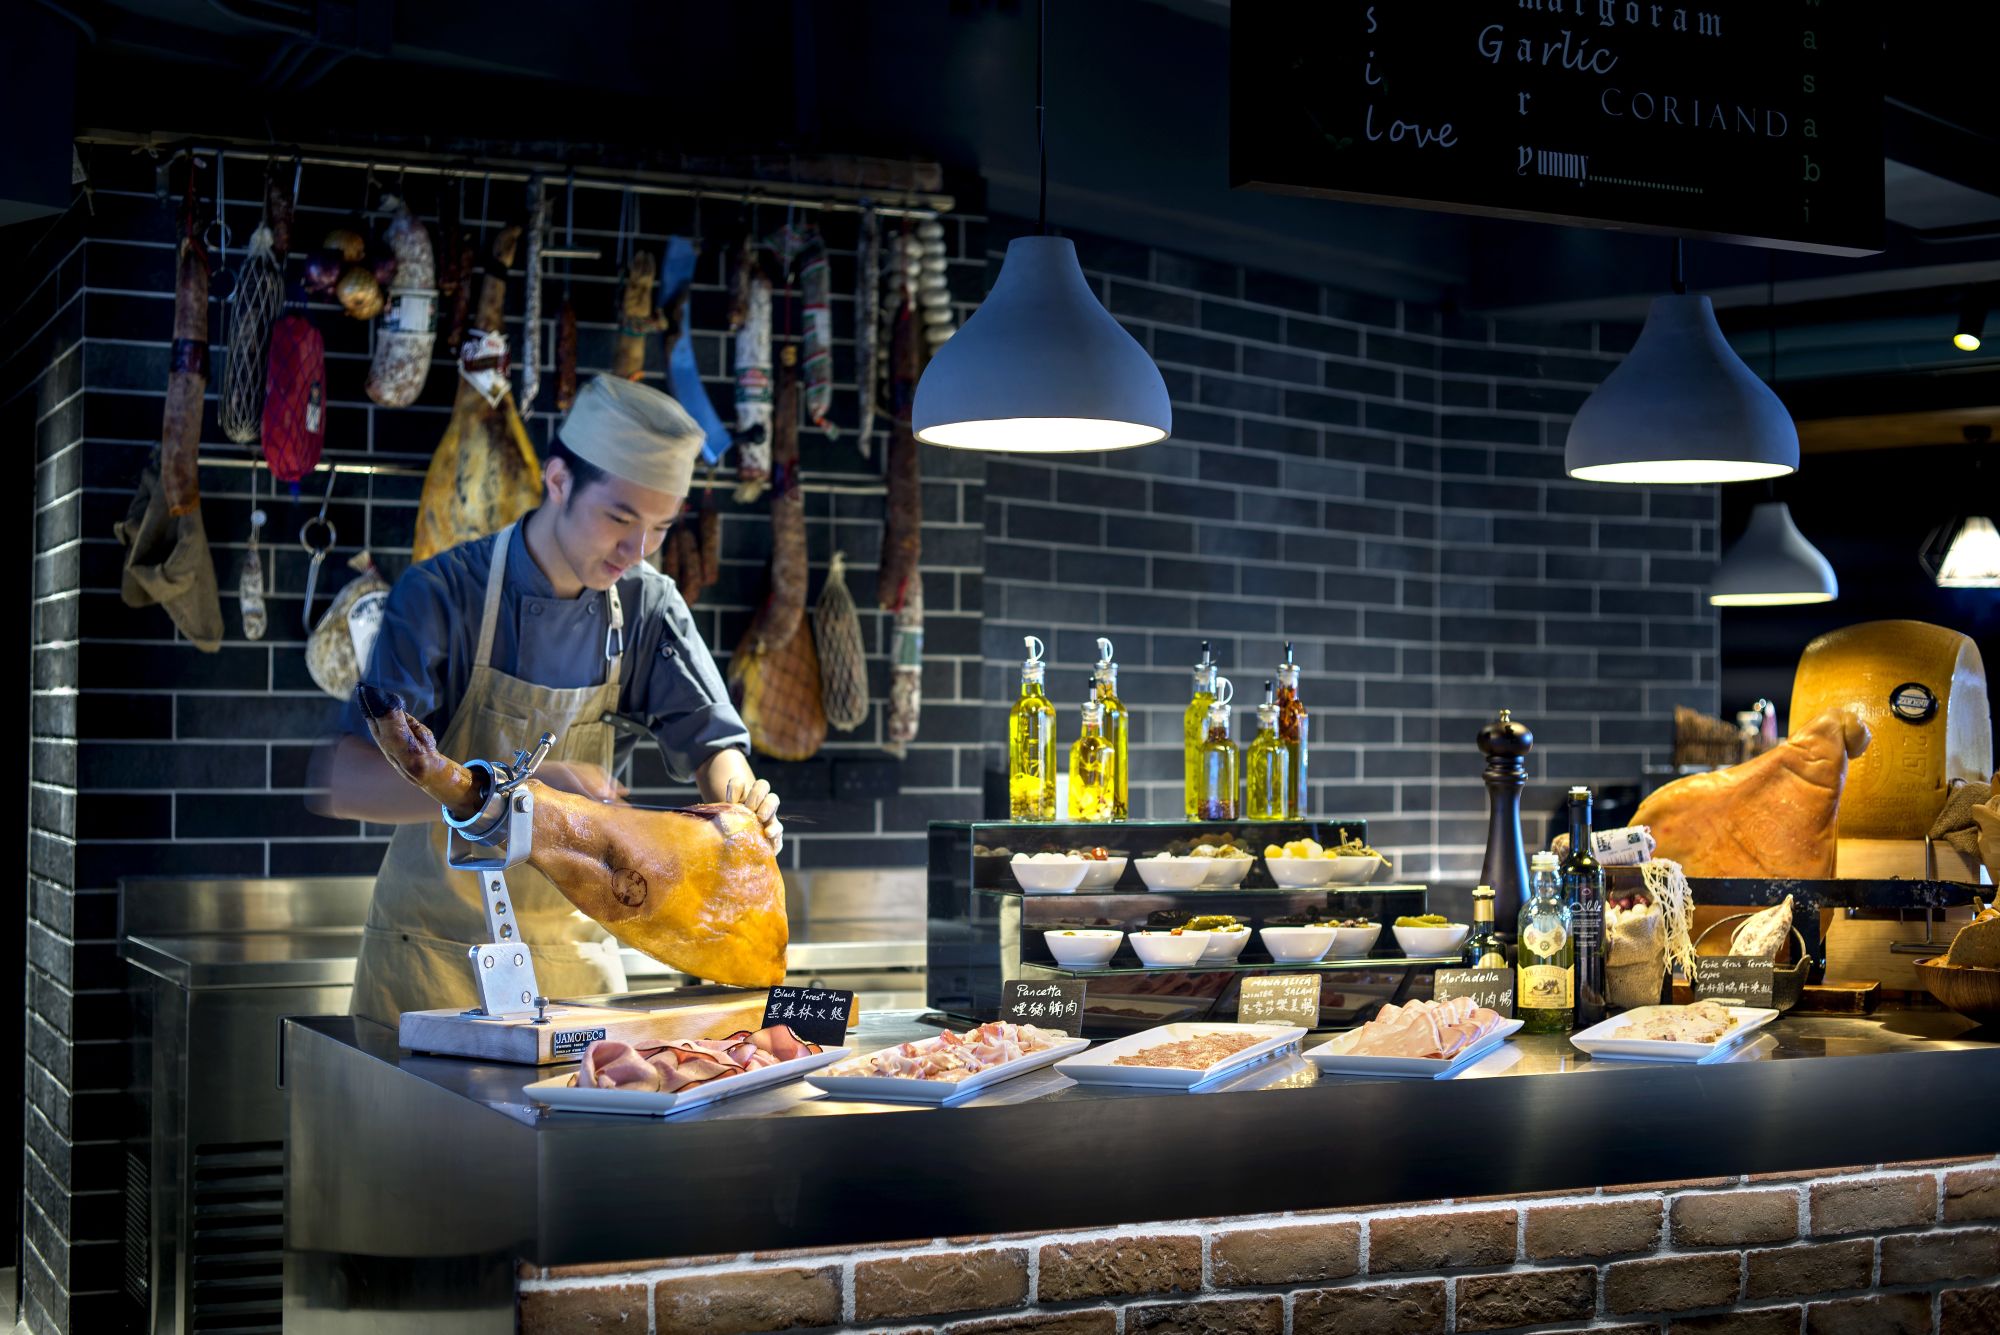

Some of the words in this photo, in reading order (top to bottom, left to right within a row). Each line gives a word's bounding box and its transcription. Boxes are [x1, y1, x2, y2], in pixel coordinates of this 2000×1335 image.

[1477, 24, 1618, 75] Garlic
[1600, 87, 1788, 138] CORIAND
[1439, 971, 1499, 984] Mortadella
[773, 988, 796, 998] Black
[800, 989, 827, 1001] Forest
[828, 991, 846, 1003] Ham
[1016, 984, 1062, 997] Pancetta
[1283, 986, 1317, 997] SALAMI
